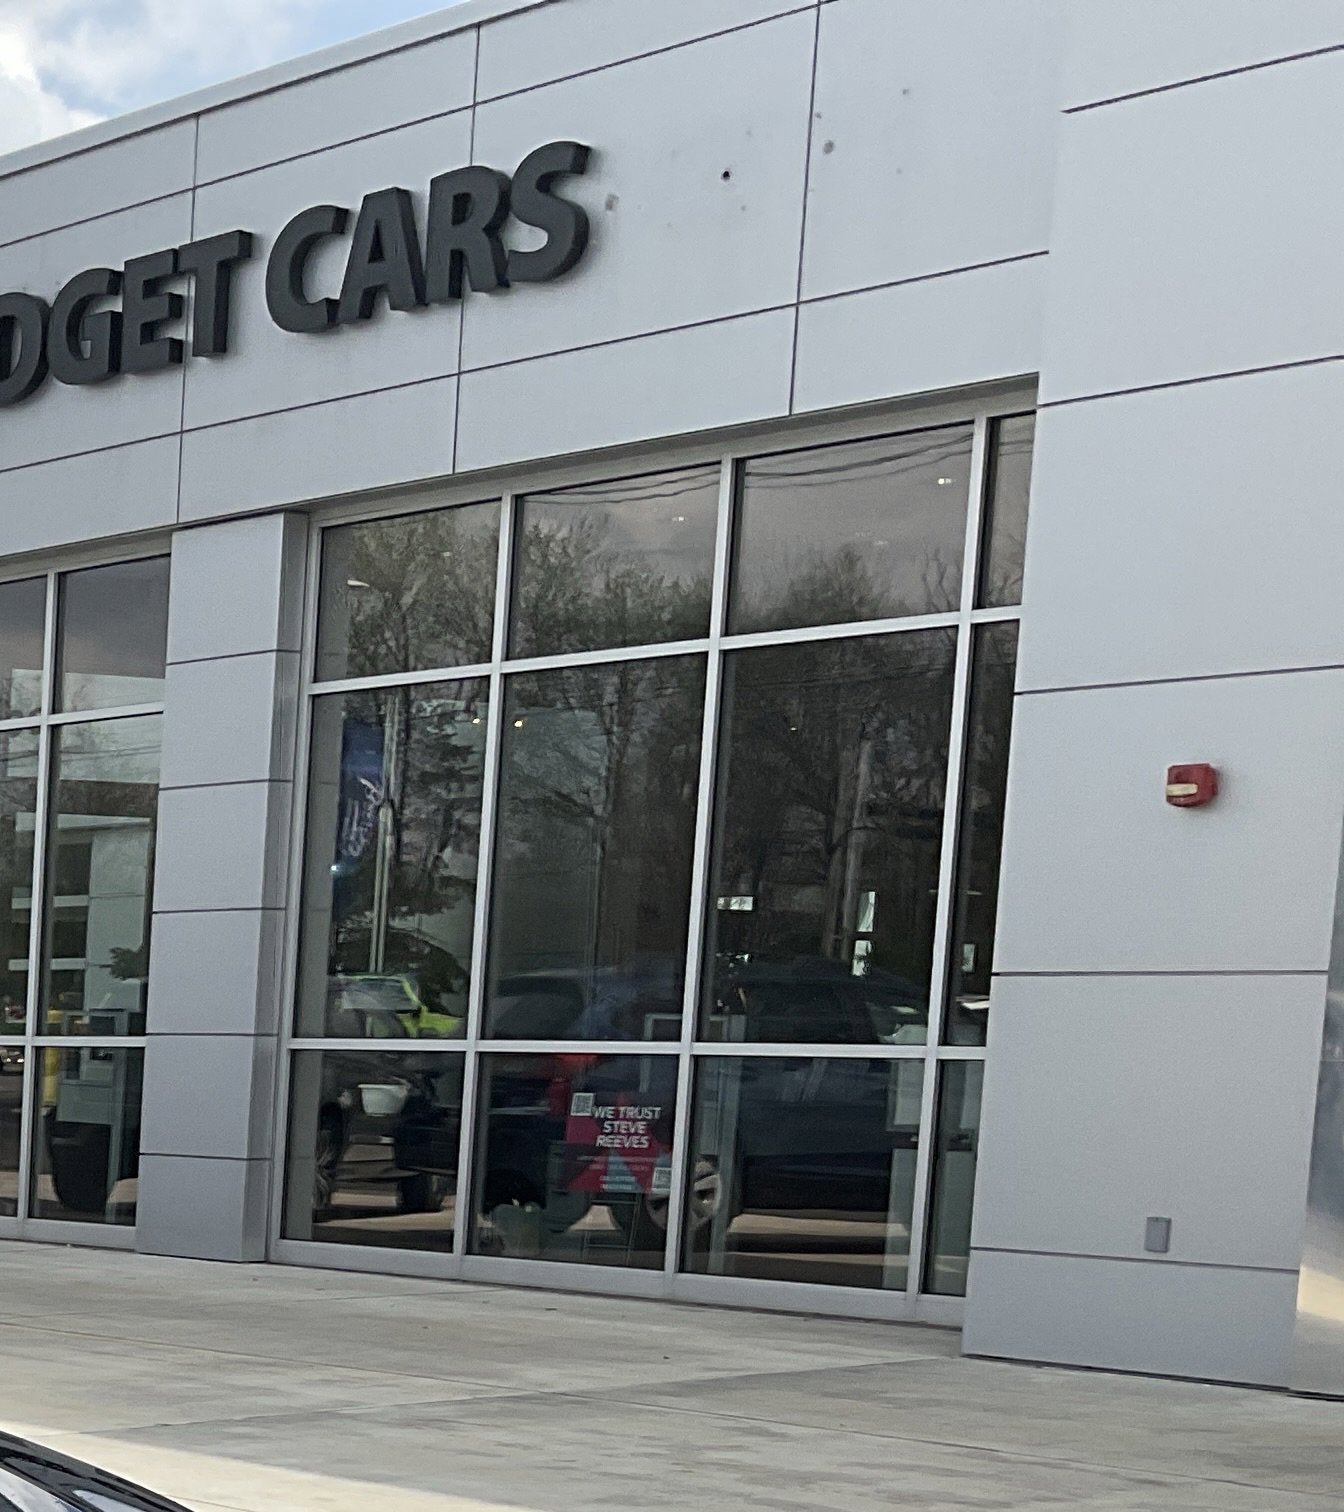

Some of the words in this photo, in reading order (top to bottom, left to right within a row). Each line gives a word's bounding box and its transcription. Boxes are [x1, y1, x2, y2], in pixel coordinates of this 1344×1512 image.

[265, 140, 593, 334] CARS
[592, 1105, 615, 1119] WE
[617, 1105, 662, 1120] TRUST
[602, 1120, 648, 1134] STEVE
[595, 1134, 651, 1149] REEVES
